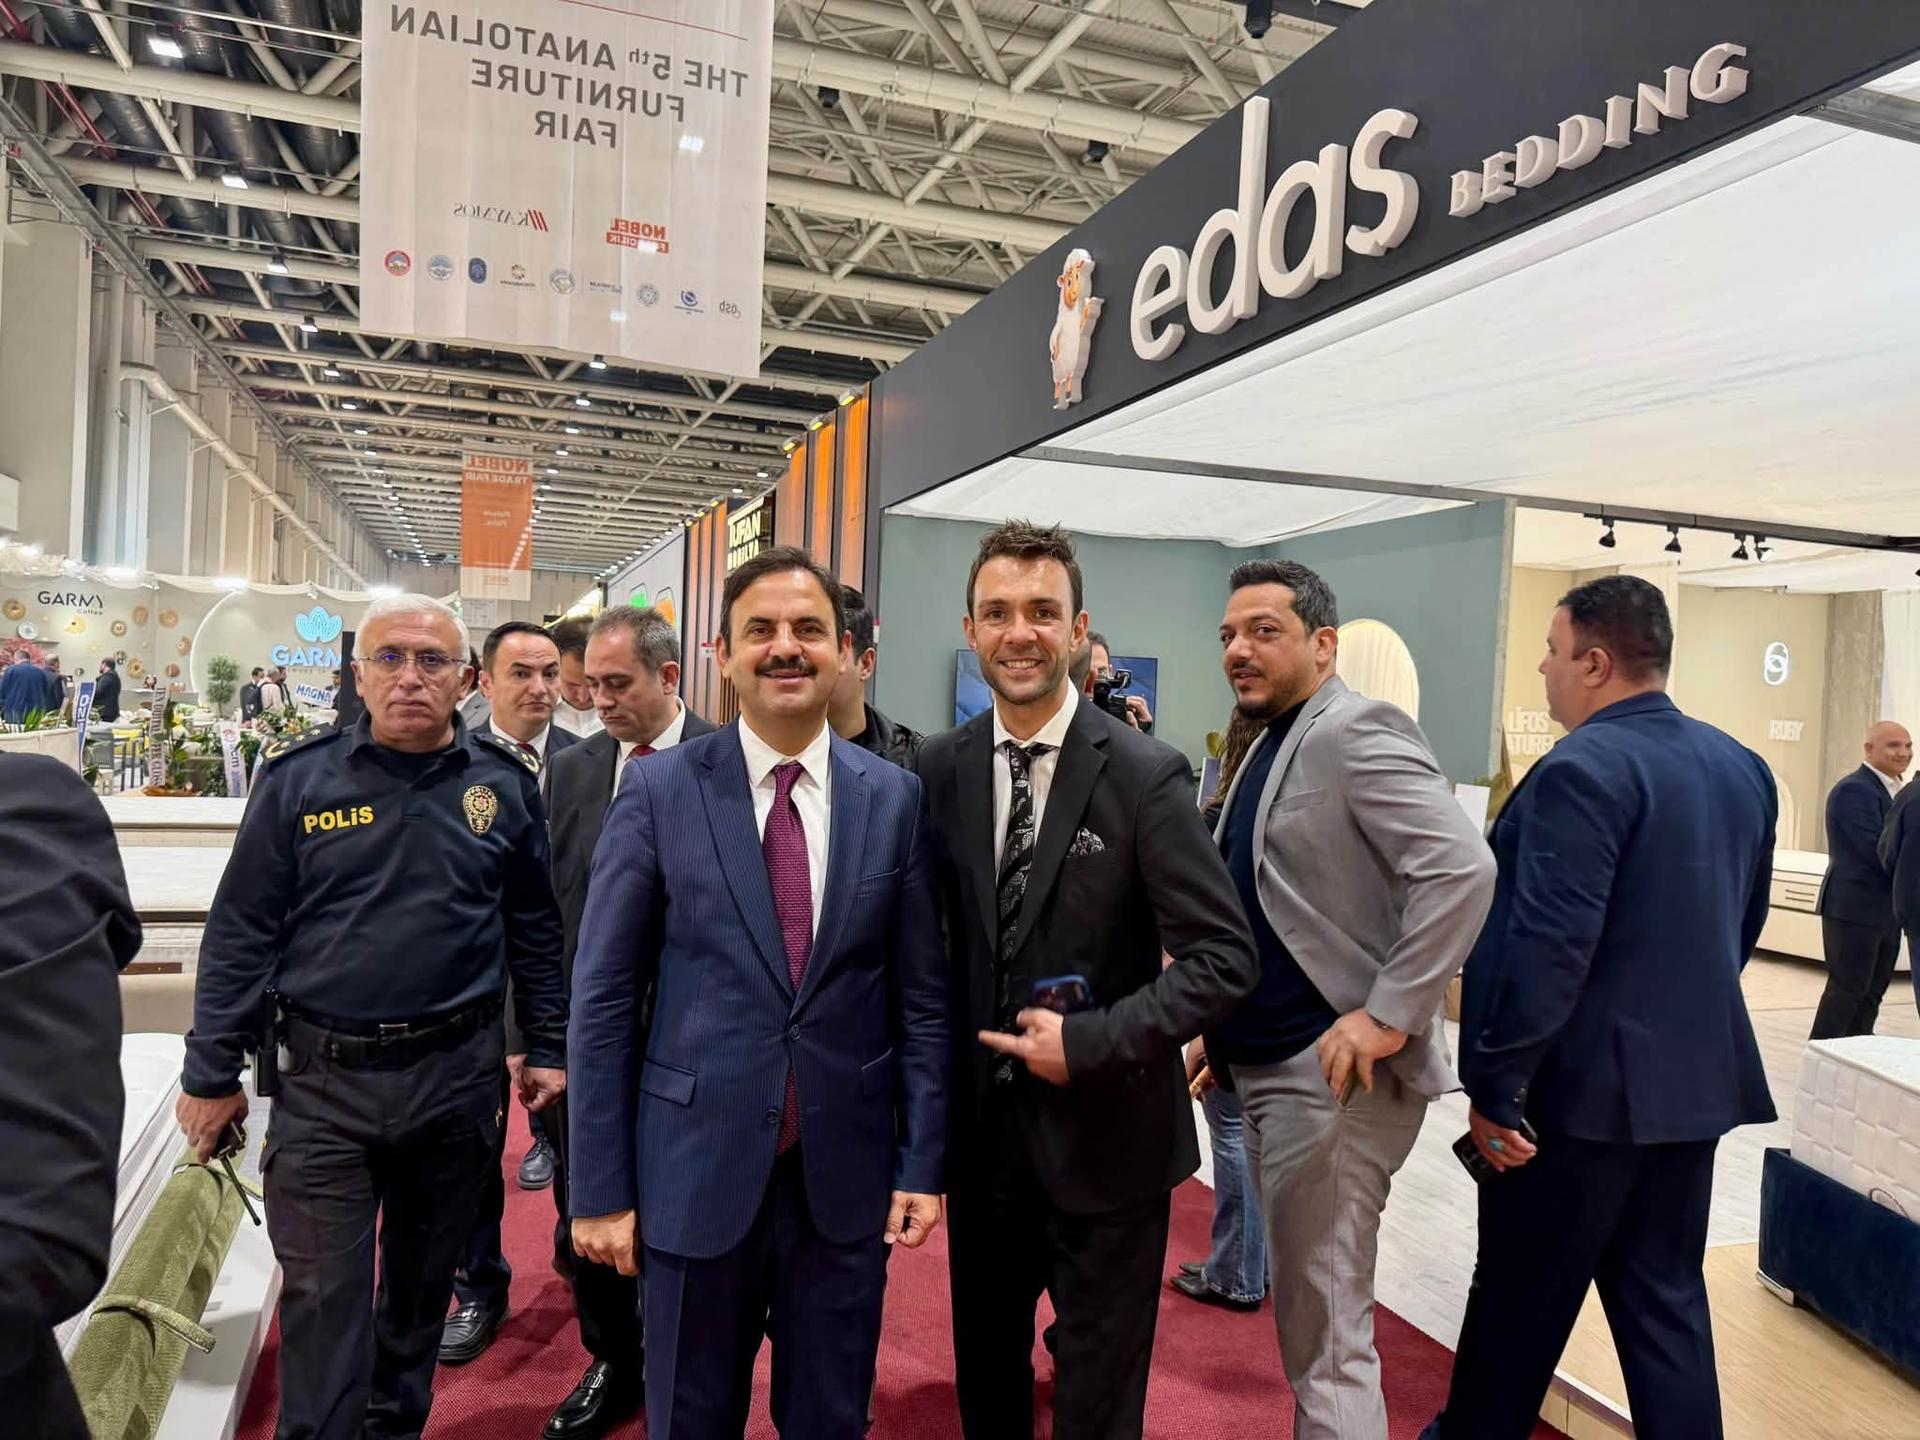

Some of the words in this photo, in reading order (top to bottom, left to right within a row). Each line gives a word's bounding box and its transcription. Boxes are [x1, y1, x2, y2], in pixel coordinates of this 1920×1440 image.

[1130, 95, 1420, 361] edas
[1449, 42, 1749, 218] BEDDING
[296, 683, 332, 703] MAGNA
